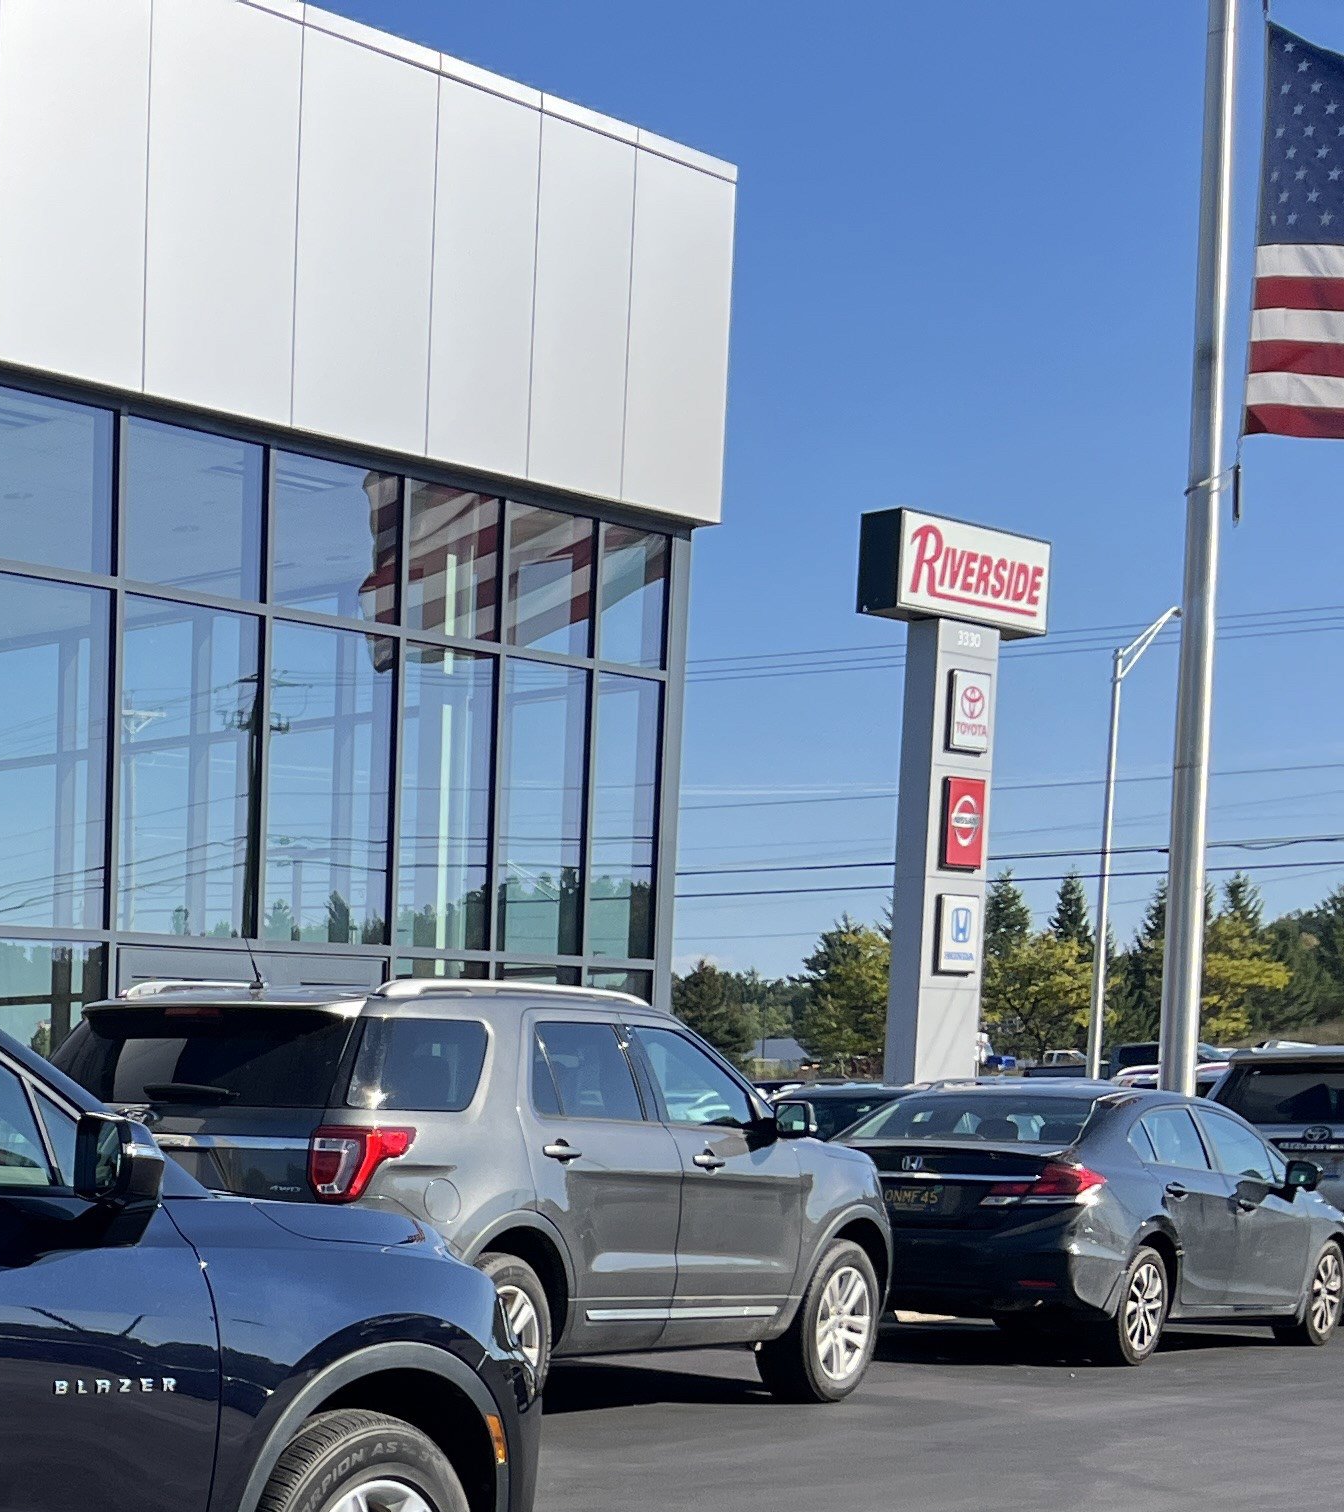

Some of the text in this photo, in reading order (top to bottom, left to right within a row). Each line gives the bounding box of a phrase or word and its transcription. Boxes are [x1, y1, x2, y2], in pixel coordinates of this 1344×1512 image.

[909, 524, 1045, 606] RIVERSIDE
[957, 629, 981, 648] 3330
[956, 721, 987, 737] TOYOTA
[944, 951, 974, 961] HONDA
[53, 1377, 178, 1395] BLAZER
